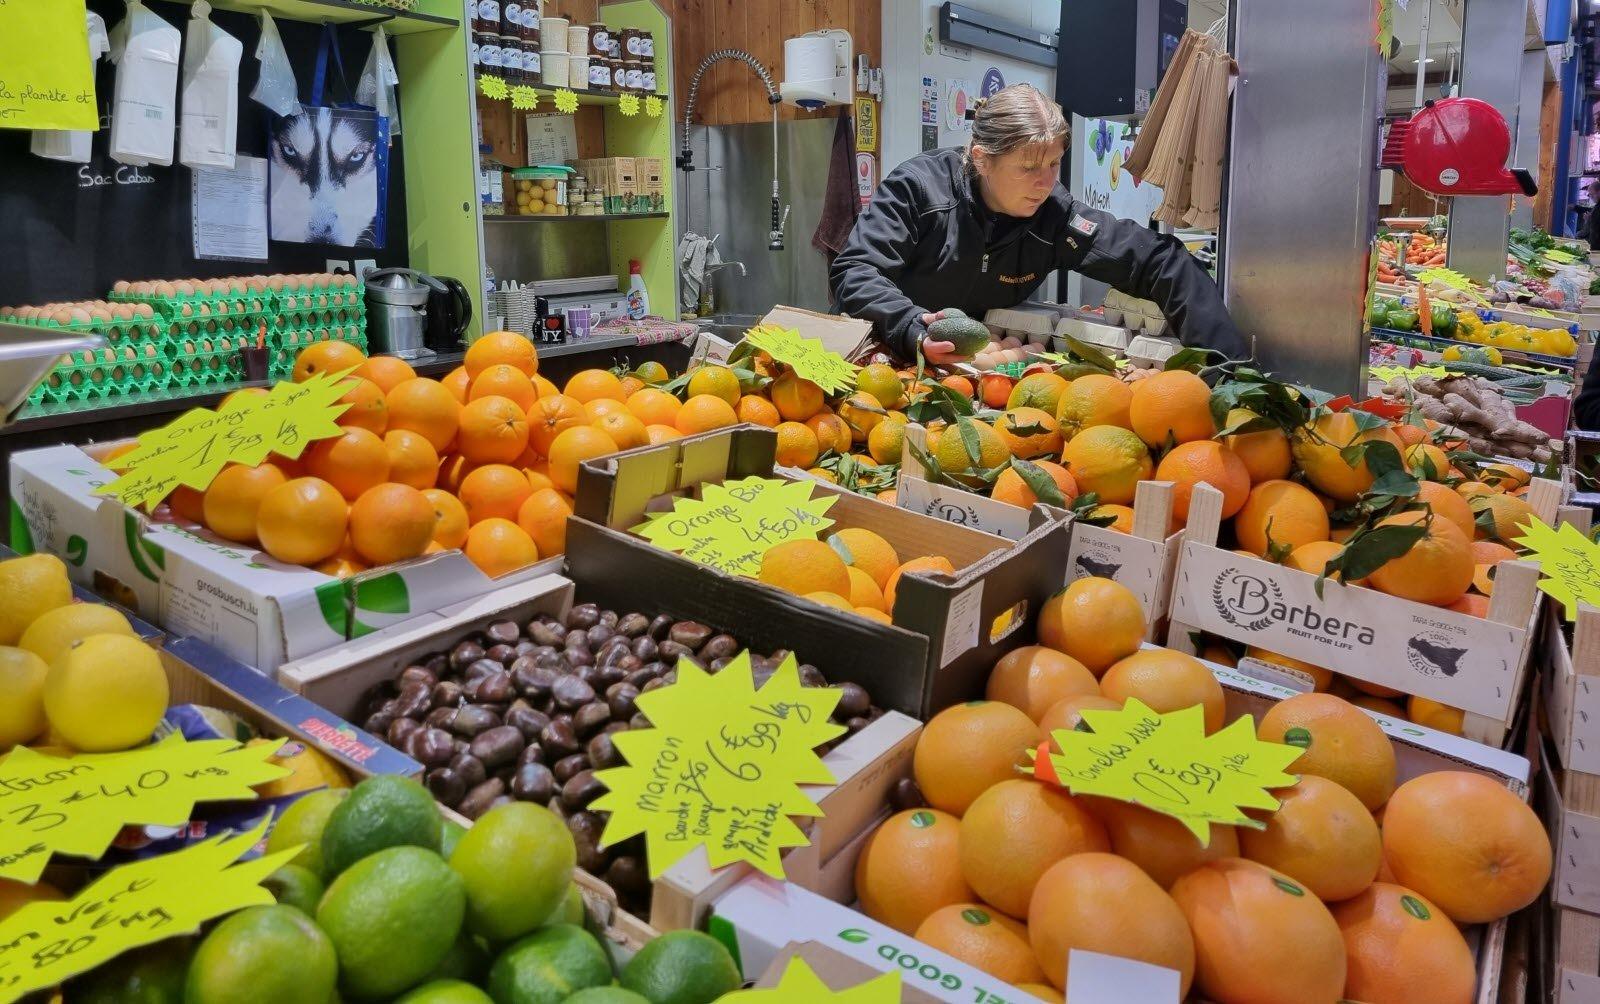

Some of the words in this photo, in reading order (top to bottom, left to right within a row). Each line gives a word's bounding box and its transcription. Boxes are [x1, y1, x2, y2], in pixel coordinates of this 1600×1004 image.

[0, 80, 14, 99] la
[20, 84, 70, 104] planète
[75, 89, 94, 104] et
[78, 165, 112, 188] Sac
[115, 165, 156, 185] Cabas
[167, 407, 254, 439] Orange
[667, 505, 743, 537] Orange
[728, 482, 765, 503] Bio
[1228, 574, 1375, 646] Barbera
[1287, 627, 1312, 640] FRUIT
[1314, 635, 1333, 645] FOR
[1334, 640, 1354, 651] LIFE
[1410, 652, 1437, 676] SICILY
[636, 736, 684, 813] Marron
[877, 944, 963, 991] GOOD
